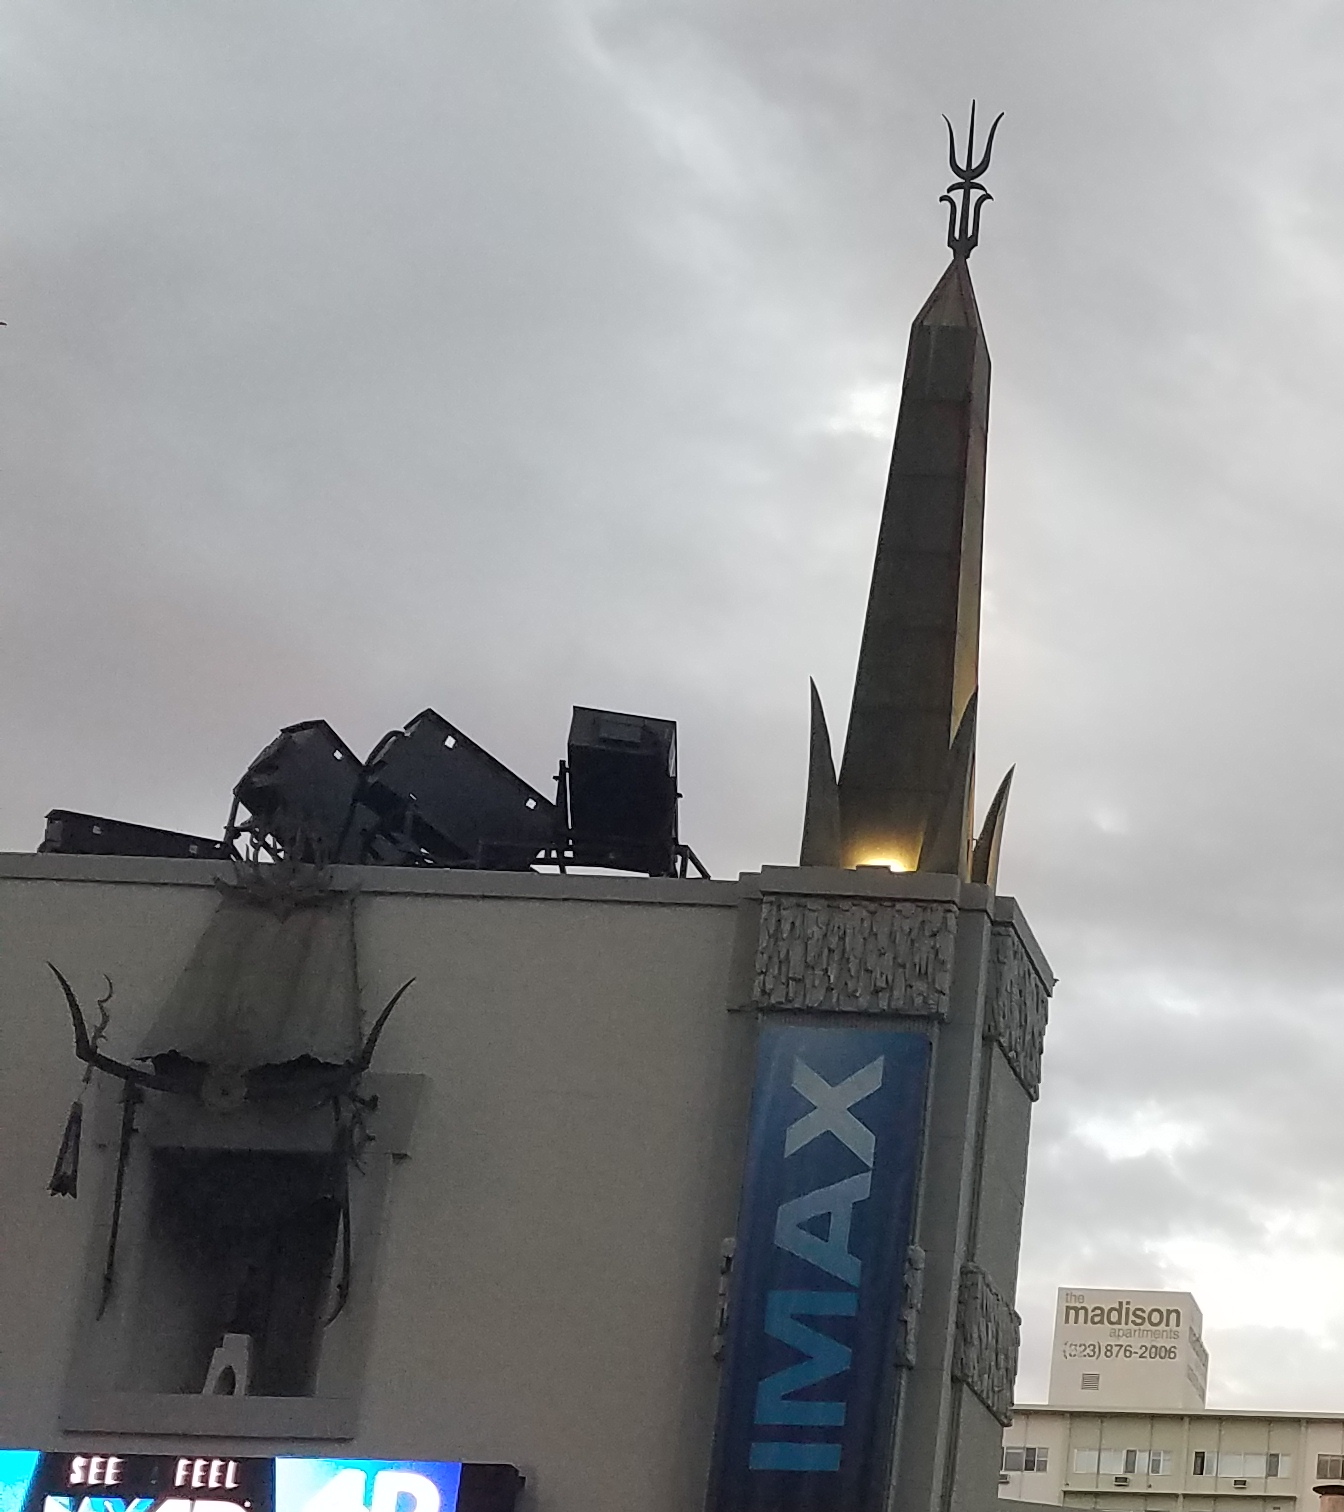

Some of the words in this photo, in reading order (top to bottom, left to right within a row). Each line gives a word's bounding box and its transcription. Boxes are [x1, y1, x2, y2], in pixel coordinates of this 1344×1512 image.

[749, 1055, 884, 1471] IMAX
[1065, 1291, 1085, 1304] the
[1064, 1300, 1181, 1328] madison
[1109, 1327, 1180, 1340] apartments
[1104, 1343, 1177, 1360] 876-2006
[70, 1456, 123, 1485] SEE
[175, 1458, 240, 1488] FEEL
